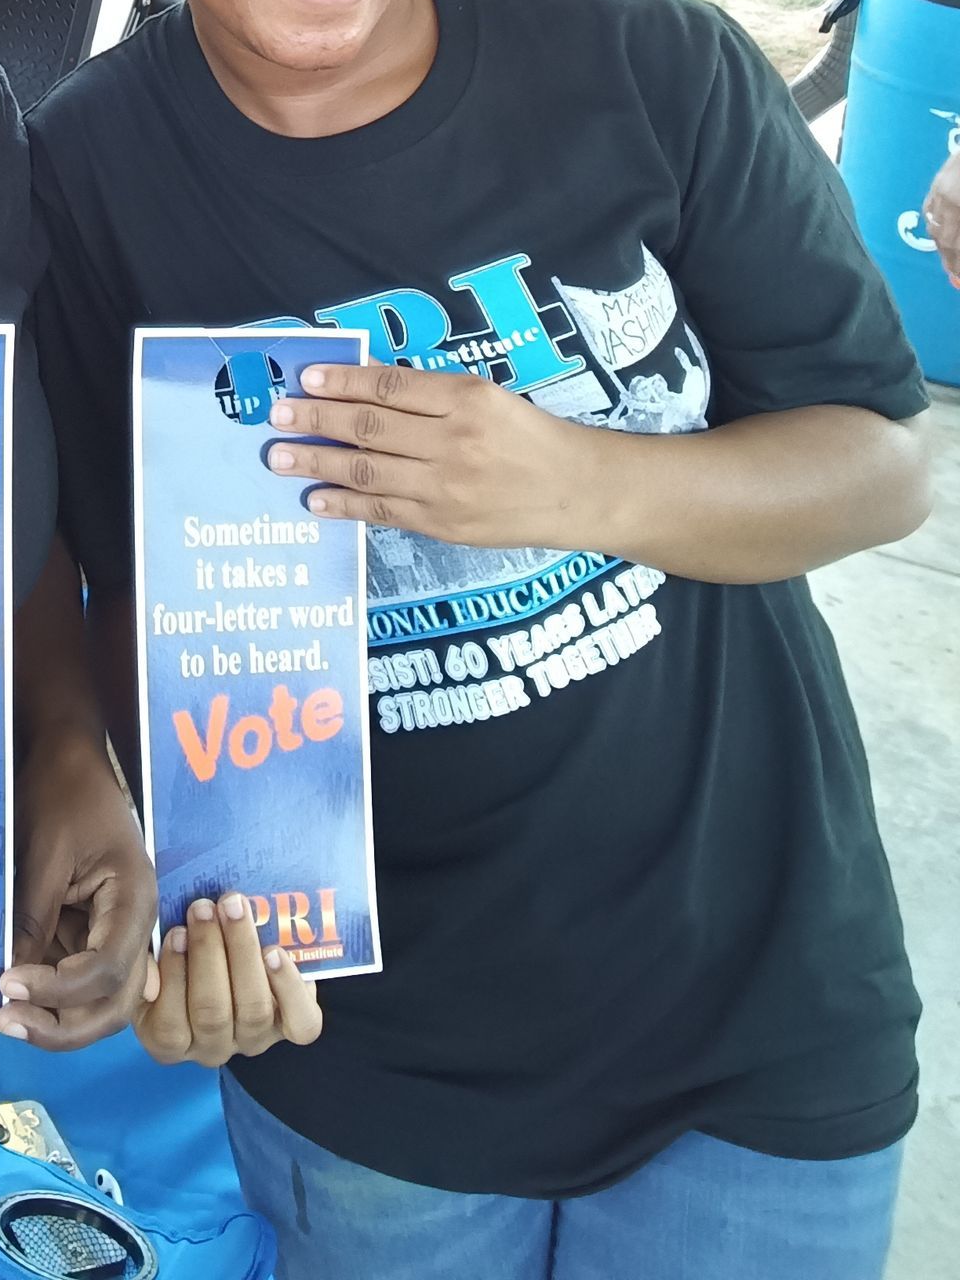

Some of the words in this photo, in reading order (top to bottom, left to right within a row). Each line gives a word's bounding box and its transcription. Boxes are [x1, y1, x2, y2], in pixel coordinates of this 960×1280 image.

[184, 514, 320, 548] Sometimes
[196, 558, 215, 591] it
[222, 557, 288, 589] takes
[294, 563, 309, 586] a
[367, 602, 450, 640] IONAL
[448, 551, 607, 627] EDUCATION
[152, 600, 282, 635] four-letter
[289, 596, 354, 629] word
[180, 648, 205, 678] to
[212, 645, 241, 675] be
[249, 640, 329, 674] heard.
[368, 649, 444, 694] SIST!
[445, 641, 489, 681] 60
[486, 603, 586, 671] YEARS
[377, 675, 531, 733] STRONGER
[172, 684, 345, 782] Vote
[299, 944, 344, 962] Institute
